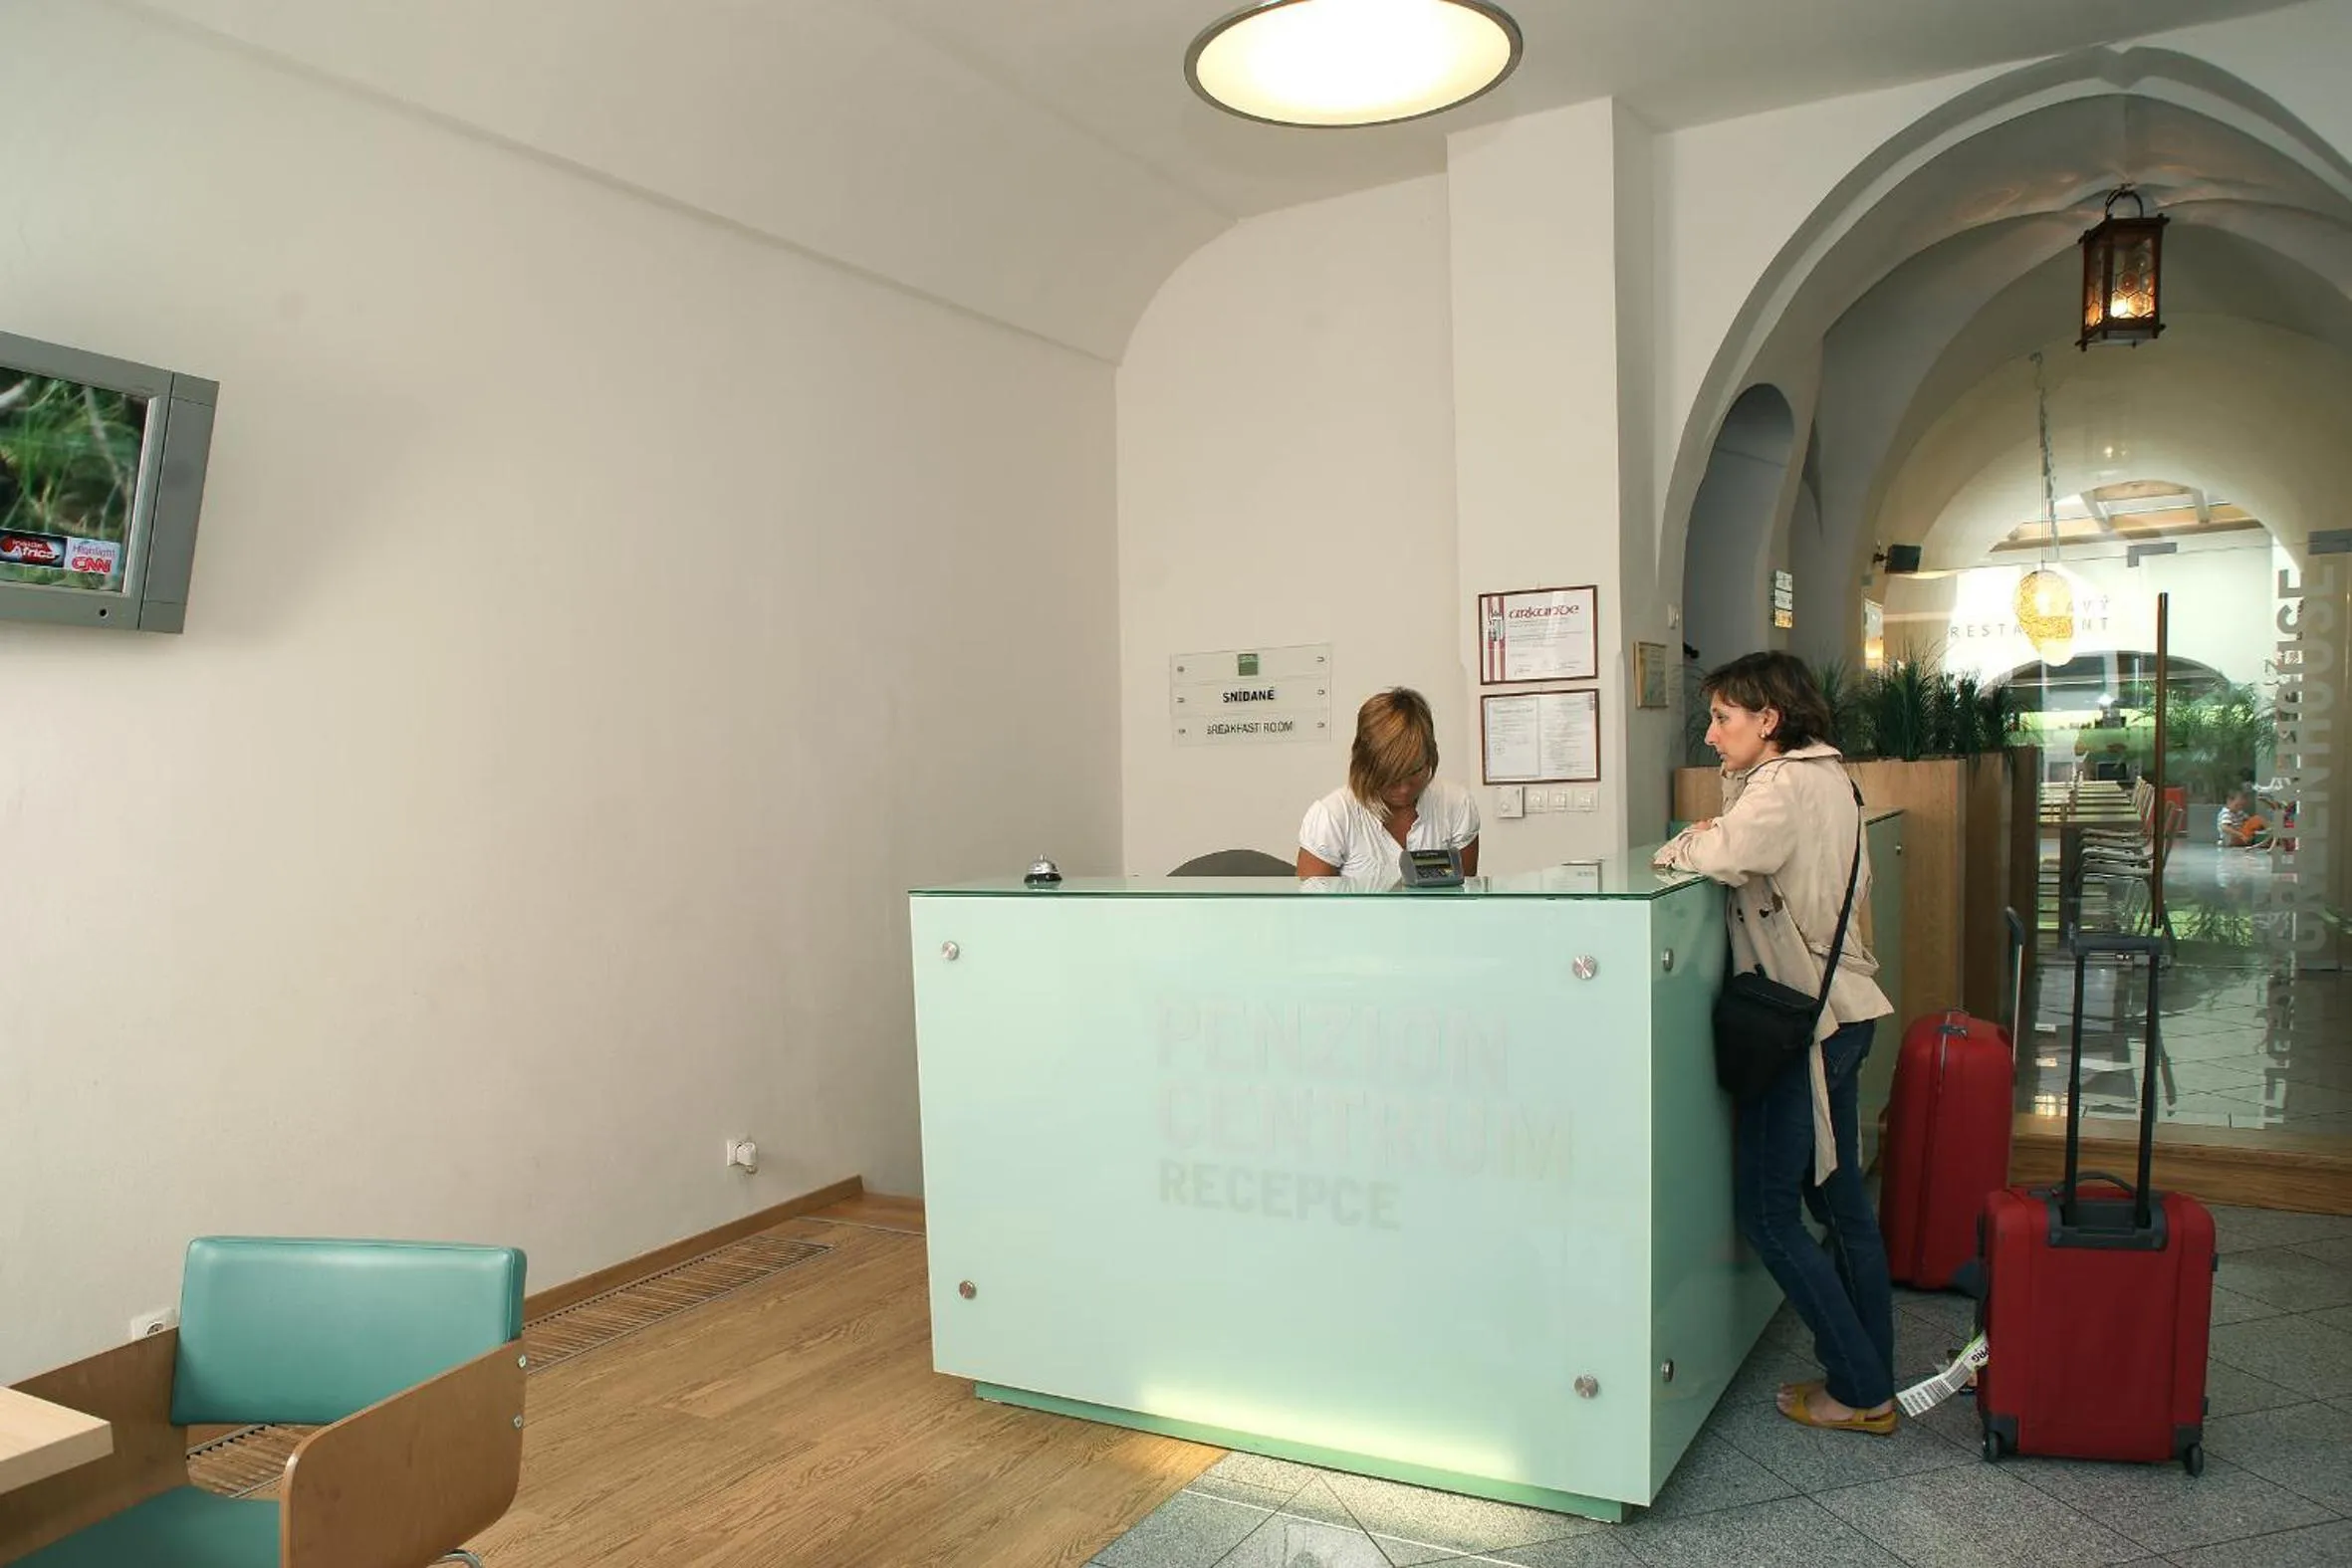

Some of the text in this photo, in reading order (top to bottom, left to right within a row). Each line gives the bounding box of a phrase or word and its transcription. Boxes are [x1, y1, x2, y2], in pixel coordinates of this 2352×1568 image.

[71, 557, 112, 573] CNN
[1950, 616, 2109, 638] RESTANT
[1206, 720, 1294, 735] BREAKFAST ROOM
[1156, 992, 1510, 1099] PENZION
[1156, 1079, 1577, 1189] CENTRUM
[1157, 1157, 1402, 1231] RECEPCE
